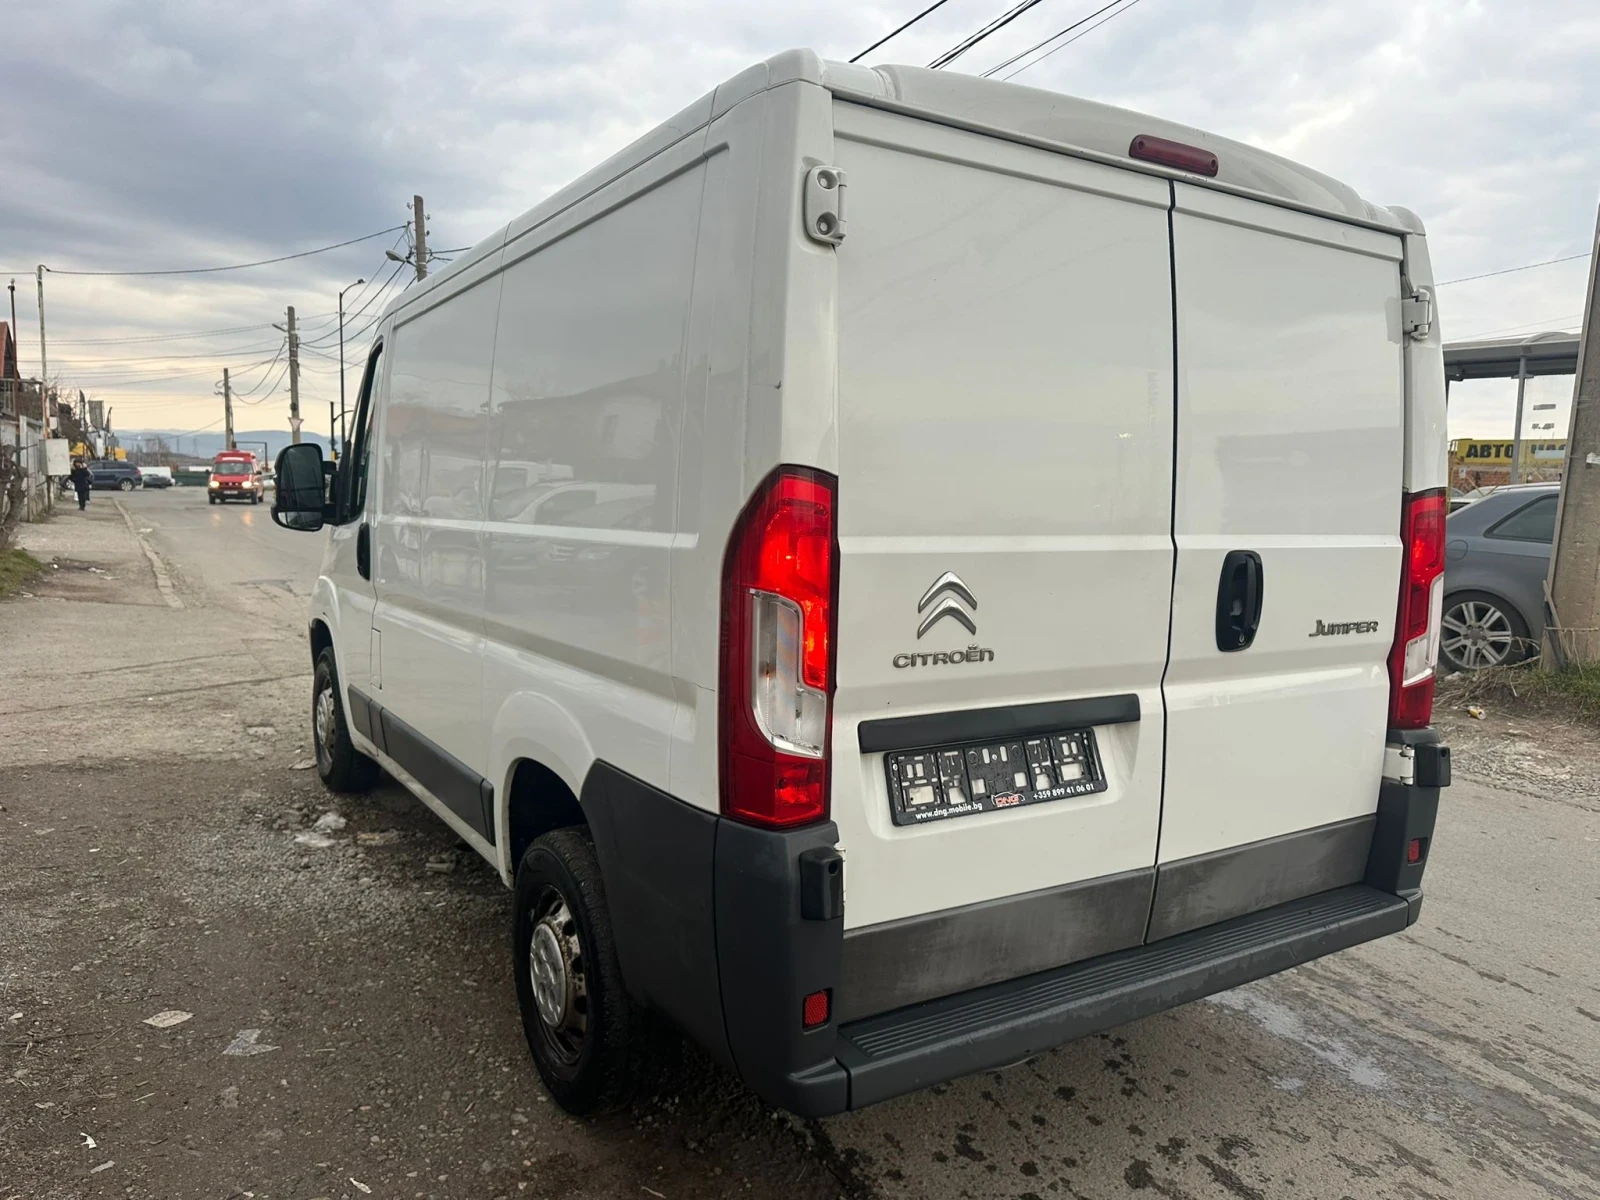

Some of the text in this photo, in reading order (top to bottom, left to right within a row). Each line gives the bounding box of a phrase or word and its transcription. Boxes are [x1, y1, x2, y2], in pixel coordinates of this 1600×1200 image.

[1033, 783, 1095, 800] +359 899 41 06 01
[915, 801, 983, 819] www.dng.mobile.bg
